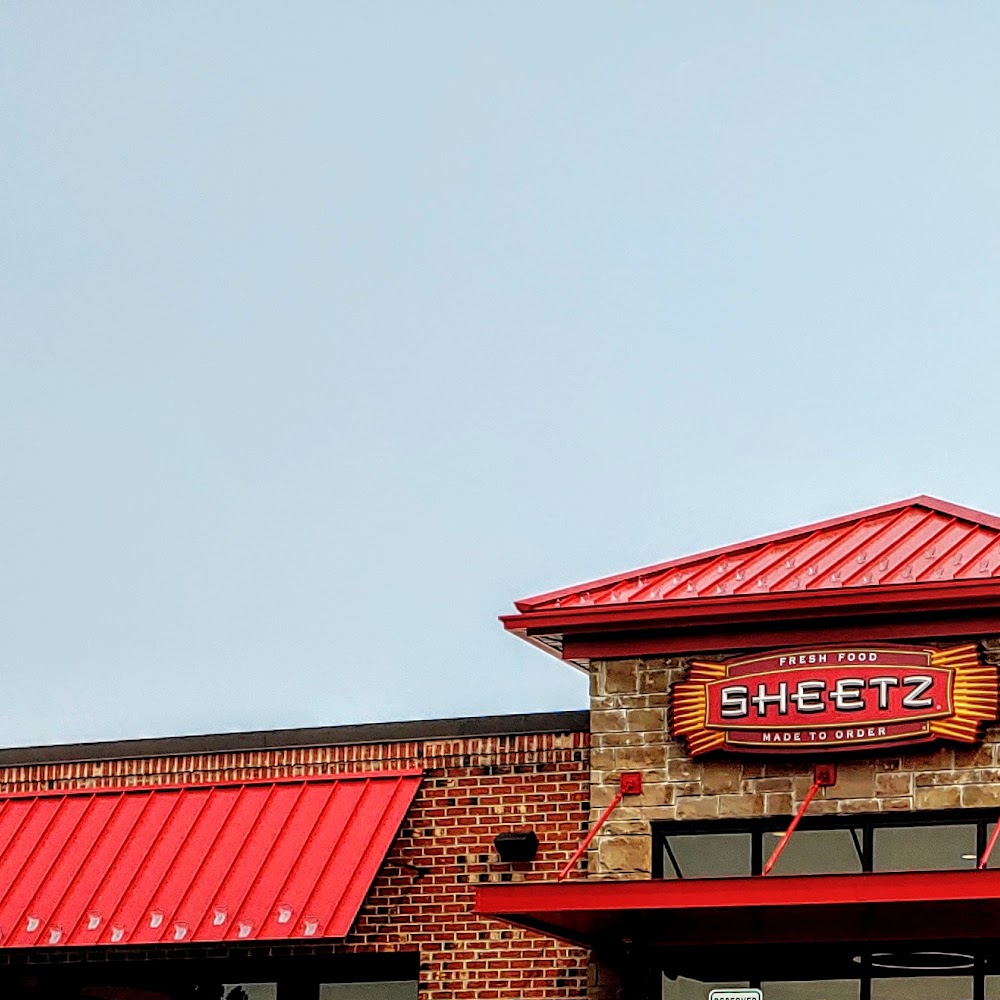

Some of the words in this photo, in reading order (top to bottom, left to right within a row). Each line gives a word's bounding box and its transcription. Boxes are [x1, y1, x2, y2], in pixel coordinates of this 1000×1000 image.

[779, 654, 828, 667] FRESH
[837, 652, 878, 663] FOOD
[720, 675, 934, 718] SHEETZ
[762, 731, 801, 742] MADE
[808, 731, 828, 741] TO
[835, 726, 887, 740] ORDER
